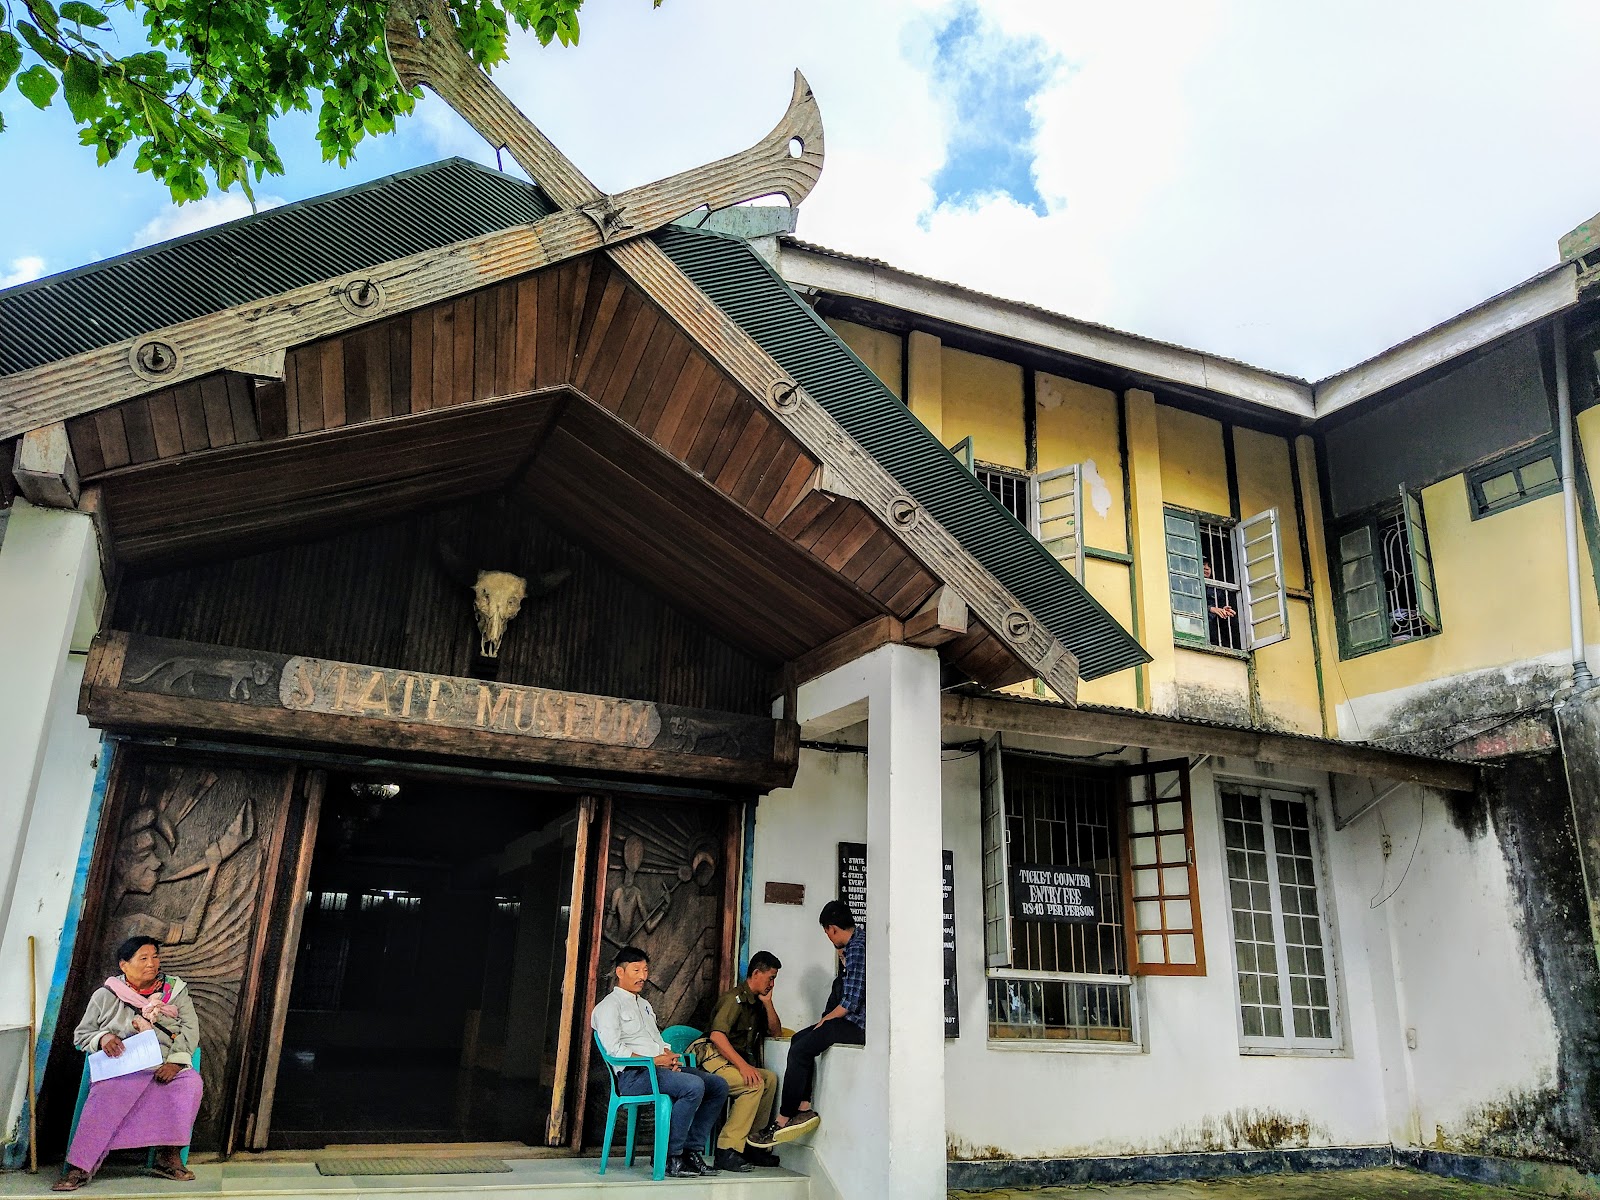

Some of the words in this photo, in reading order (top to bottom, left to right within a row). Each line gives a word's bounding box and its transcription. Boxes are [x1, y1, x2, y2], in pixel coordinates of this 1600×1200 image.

[292, 660, 458, 722] STATE
[475, 682, 652, 745] MUSEUM
[848, 857, 865, 865] STATE
[1019, 869, 1052, 885] TICKET
[1053, 872, 1091, 888] COUNTER
[1029, 885, 1062, 905] ENTRY
[1062, 887, 1082, 905] FEE
[1046, 903, 1064, 916] PER
[1064, 905, 1095, 917] PERSON
